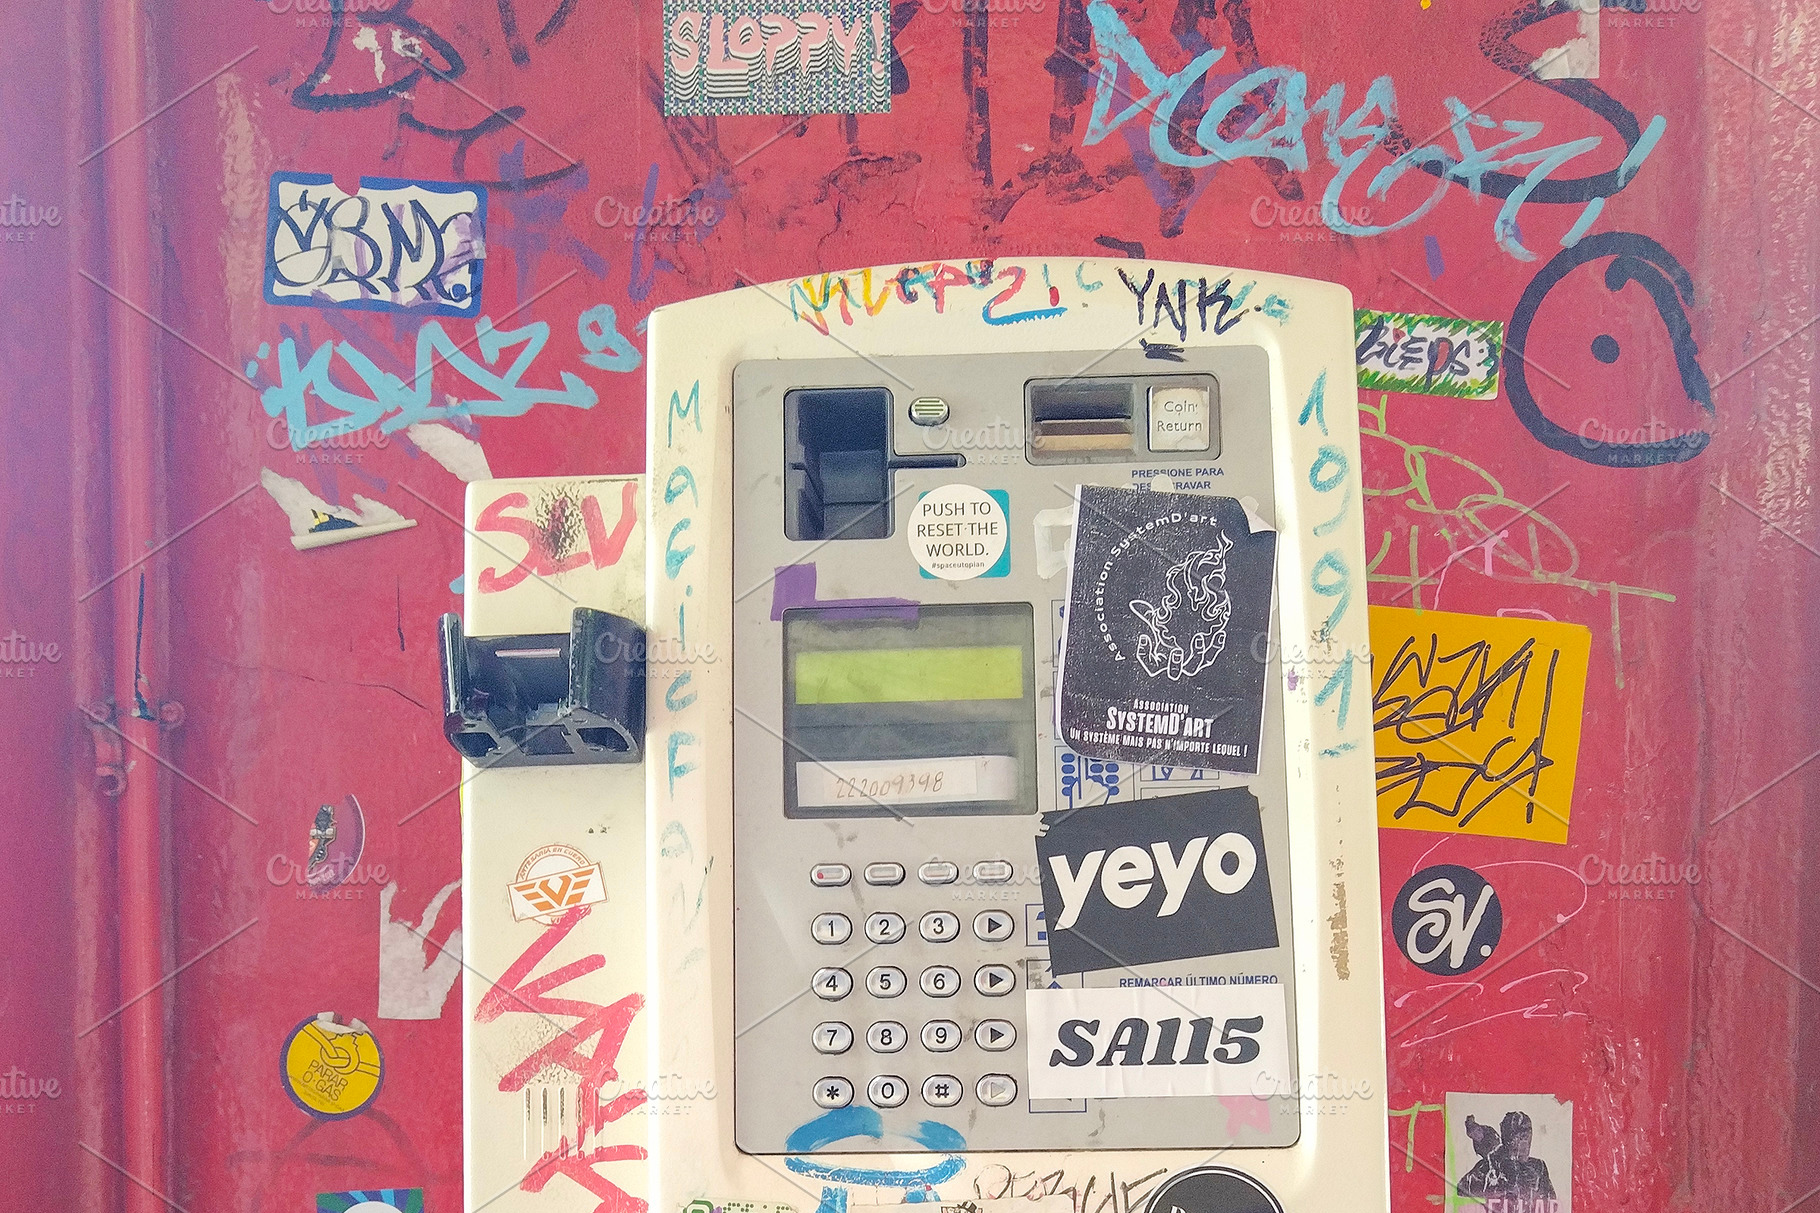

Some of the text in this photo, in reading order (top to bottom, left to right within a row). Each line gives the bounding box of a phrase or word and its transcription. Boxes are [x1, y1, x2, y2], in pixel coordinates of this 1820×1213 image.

[671, 10, 885, 97] SLOPPY!
[1164, 400, 1196, 414] Coin
[1157, 420, 1203, 433] Return
[1131, 467, 1225, 479] PRESSIONE PARA
[922, 501, 991, 517] PUSH TO
[916, 521, 999, 538] RESET THE
[925, 542, 989, 557] WORLD.
[1094, 560, 1126, 663] Association
[1048, 832, 1257, 931] yeyo
[827, 917, 944, 937] 1 2 3
[825, 973, 946, 992] 4 5 6
[1119, 971, 1279, 988] REMARCAR ÚLTIMO NÚMERO
[826, 1027, 948, 1047] 7 8 9
[307, 1059, 349, 1092] PARAR
[881, 1082, 895, 1099] 0
